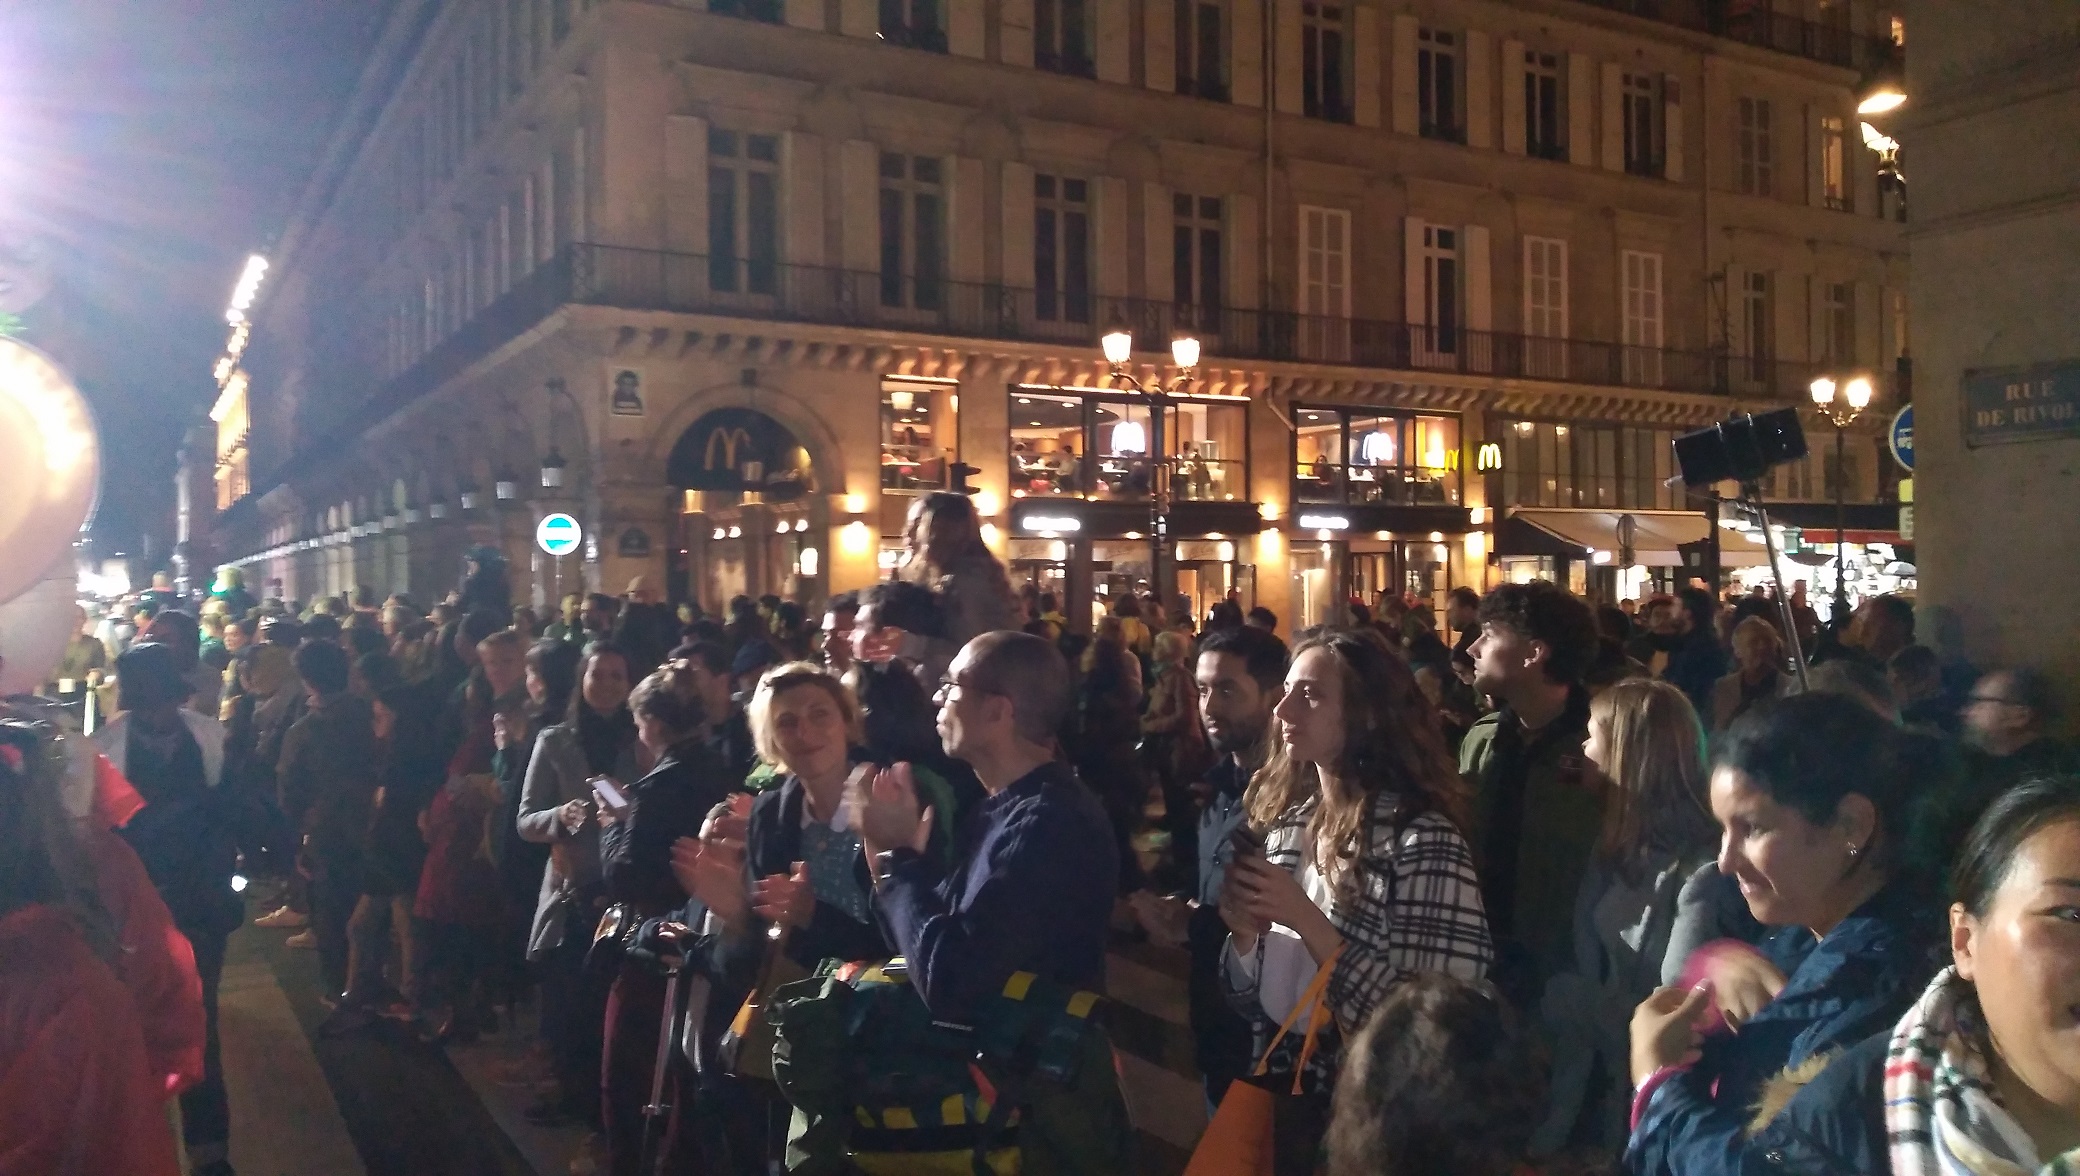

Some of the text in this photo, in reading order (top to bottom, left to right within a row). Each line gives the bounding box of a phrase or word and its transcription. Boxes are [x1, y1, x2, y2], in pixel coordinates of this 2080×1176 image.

[2005, 380, 2056, 401] RUE
[1977, 409, 2005, 427] DE
[1478, 443, 1501, 470] M
